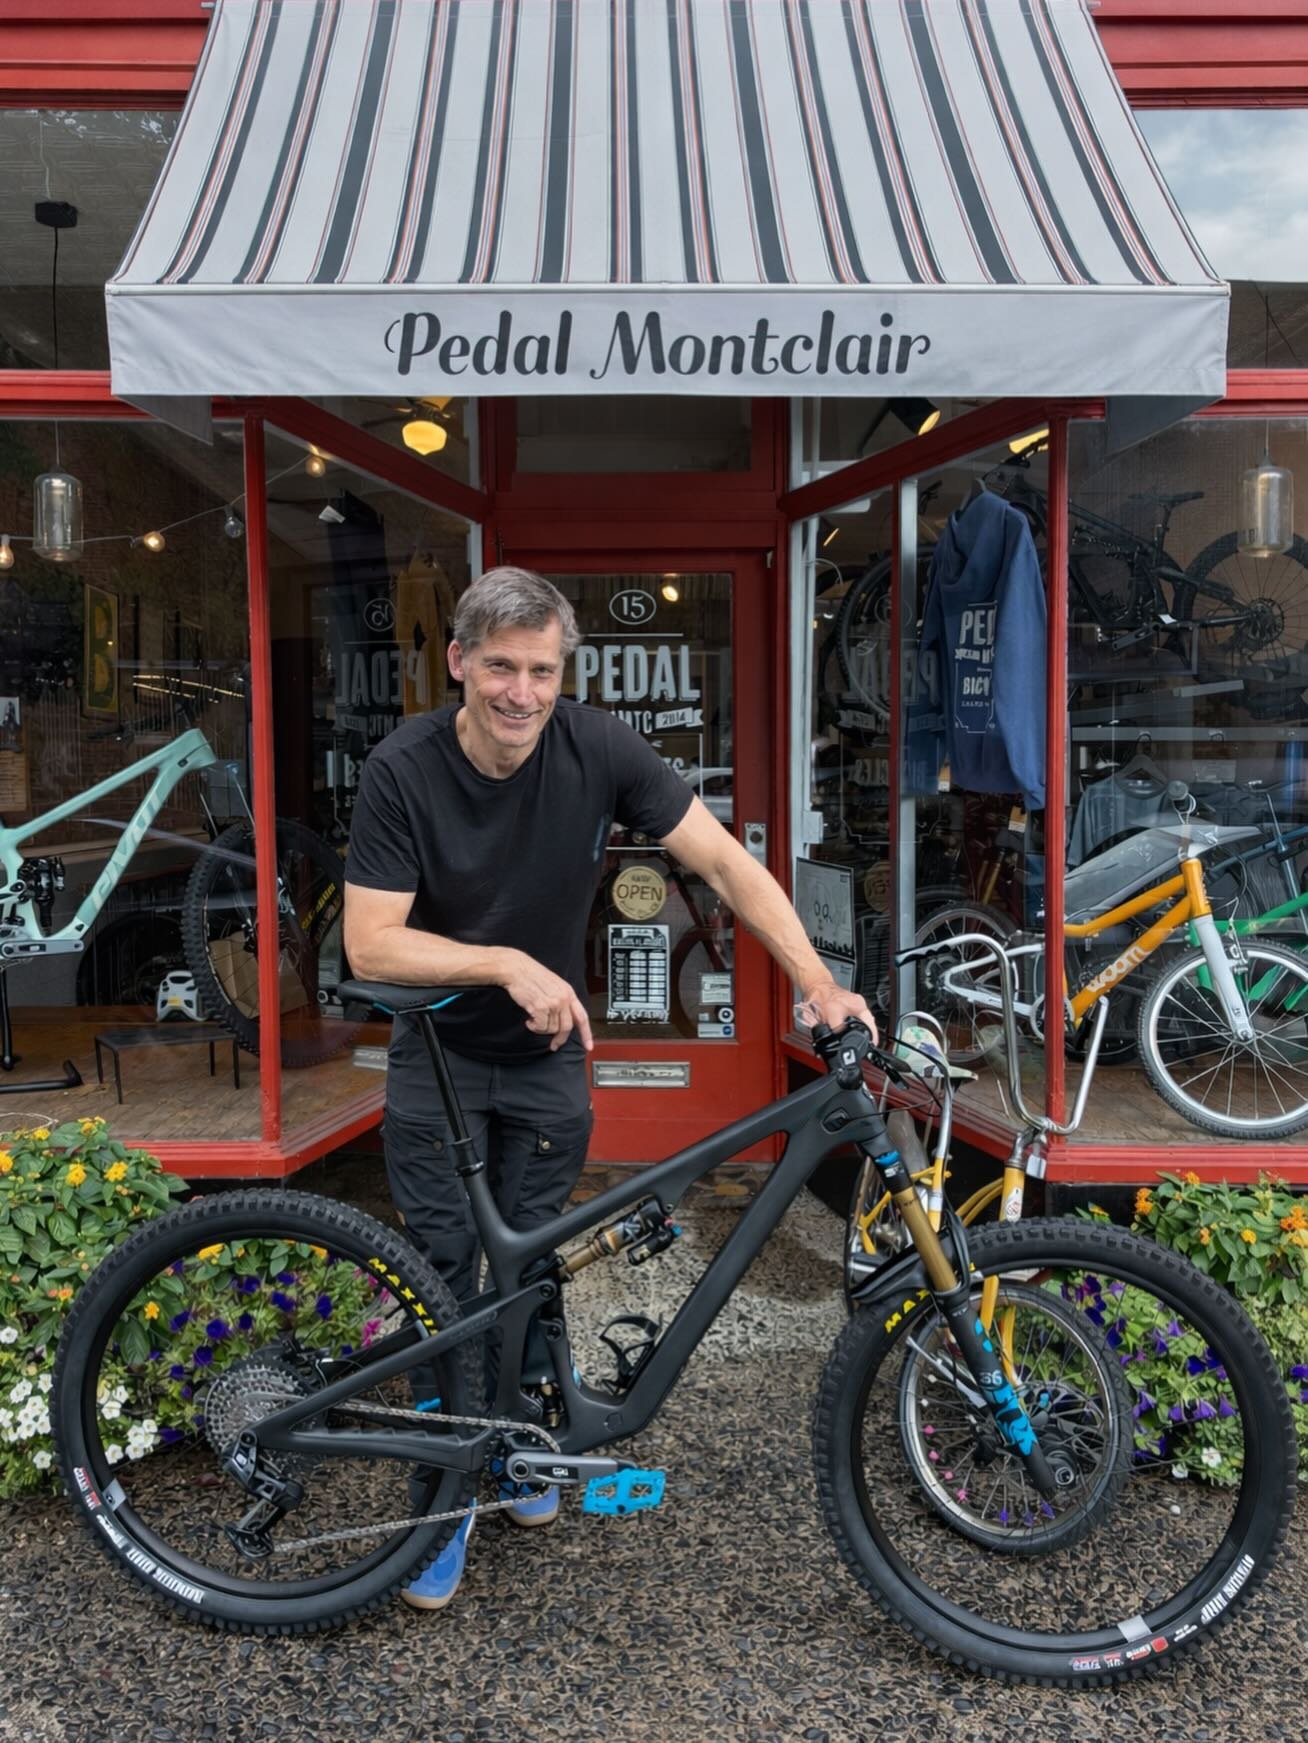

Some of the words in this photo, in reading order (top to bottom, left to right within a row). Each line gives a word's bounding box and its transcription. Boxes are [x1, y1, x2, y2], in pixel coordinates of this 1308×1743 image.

[384, 310, 573, 375] Pedal
[589, 310, 931, 380] Montclair
[621, 595, 646, 620] 15
[575, 644, 701, 703] PEDAL
[616, 884, 663, 902] OPEN
